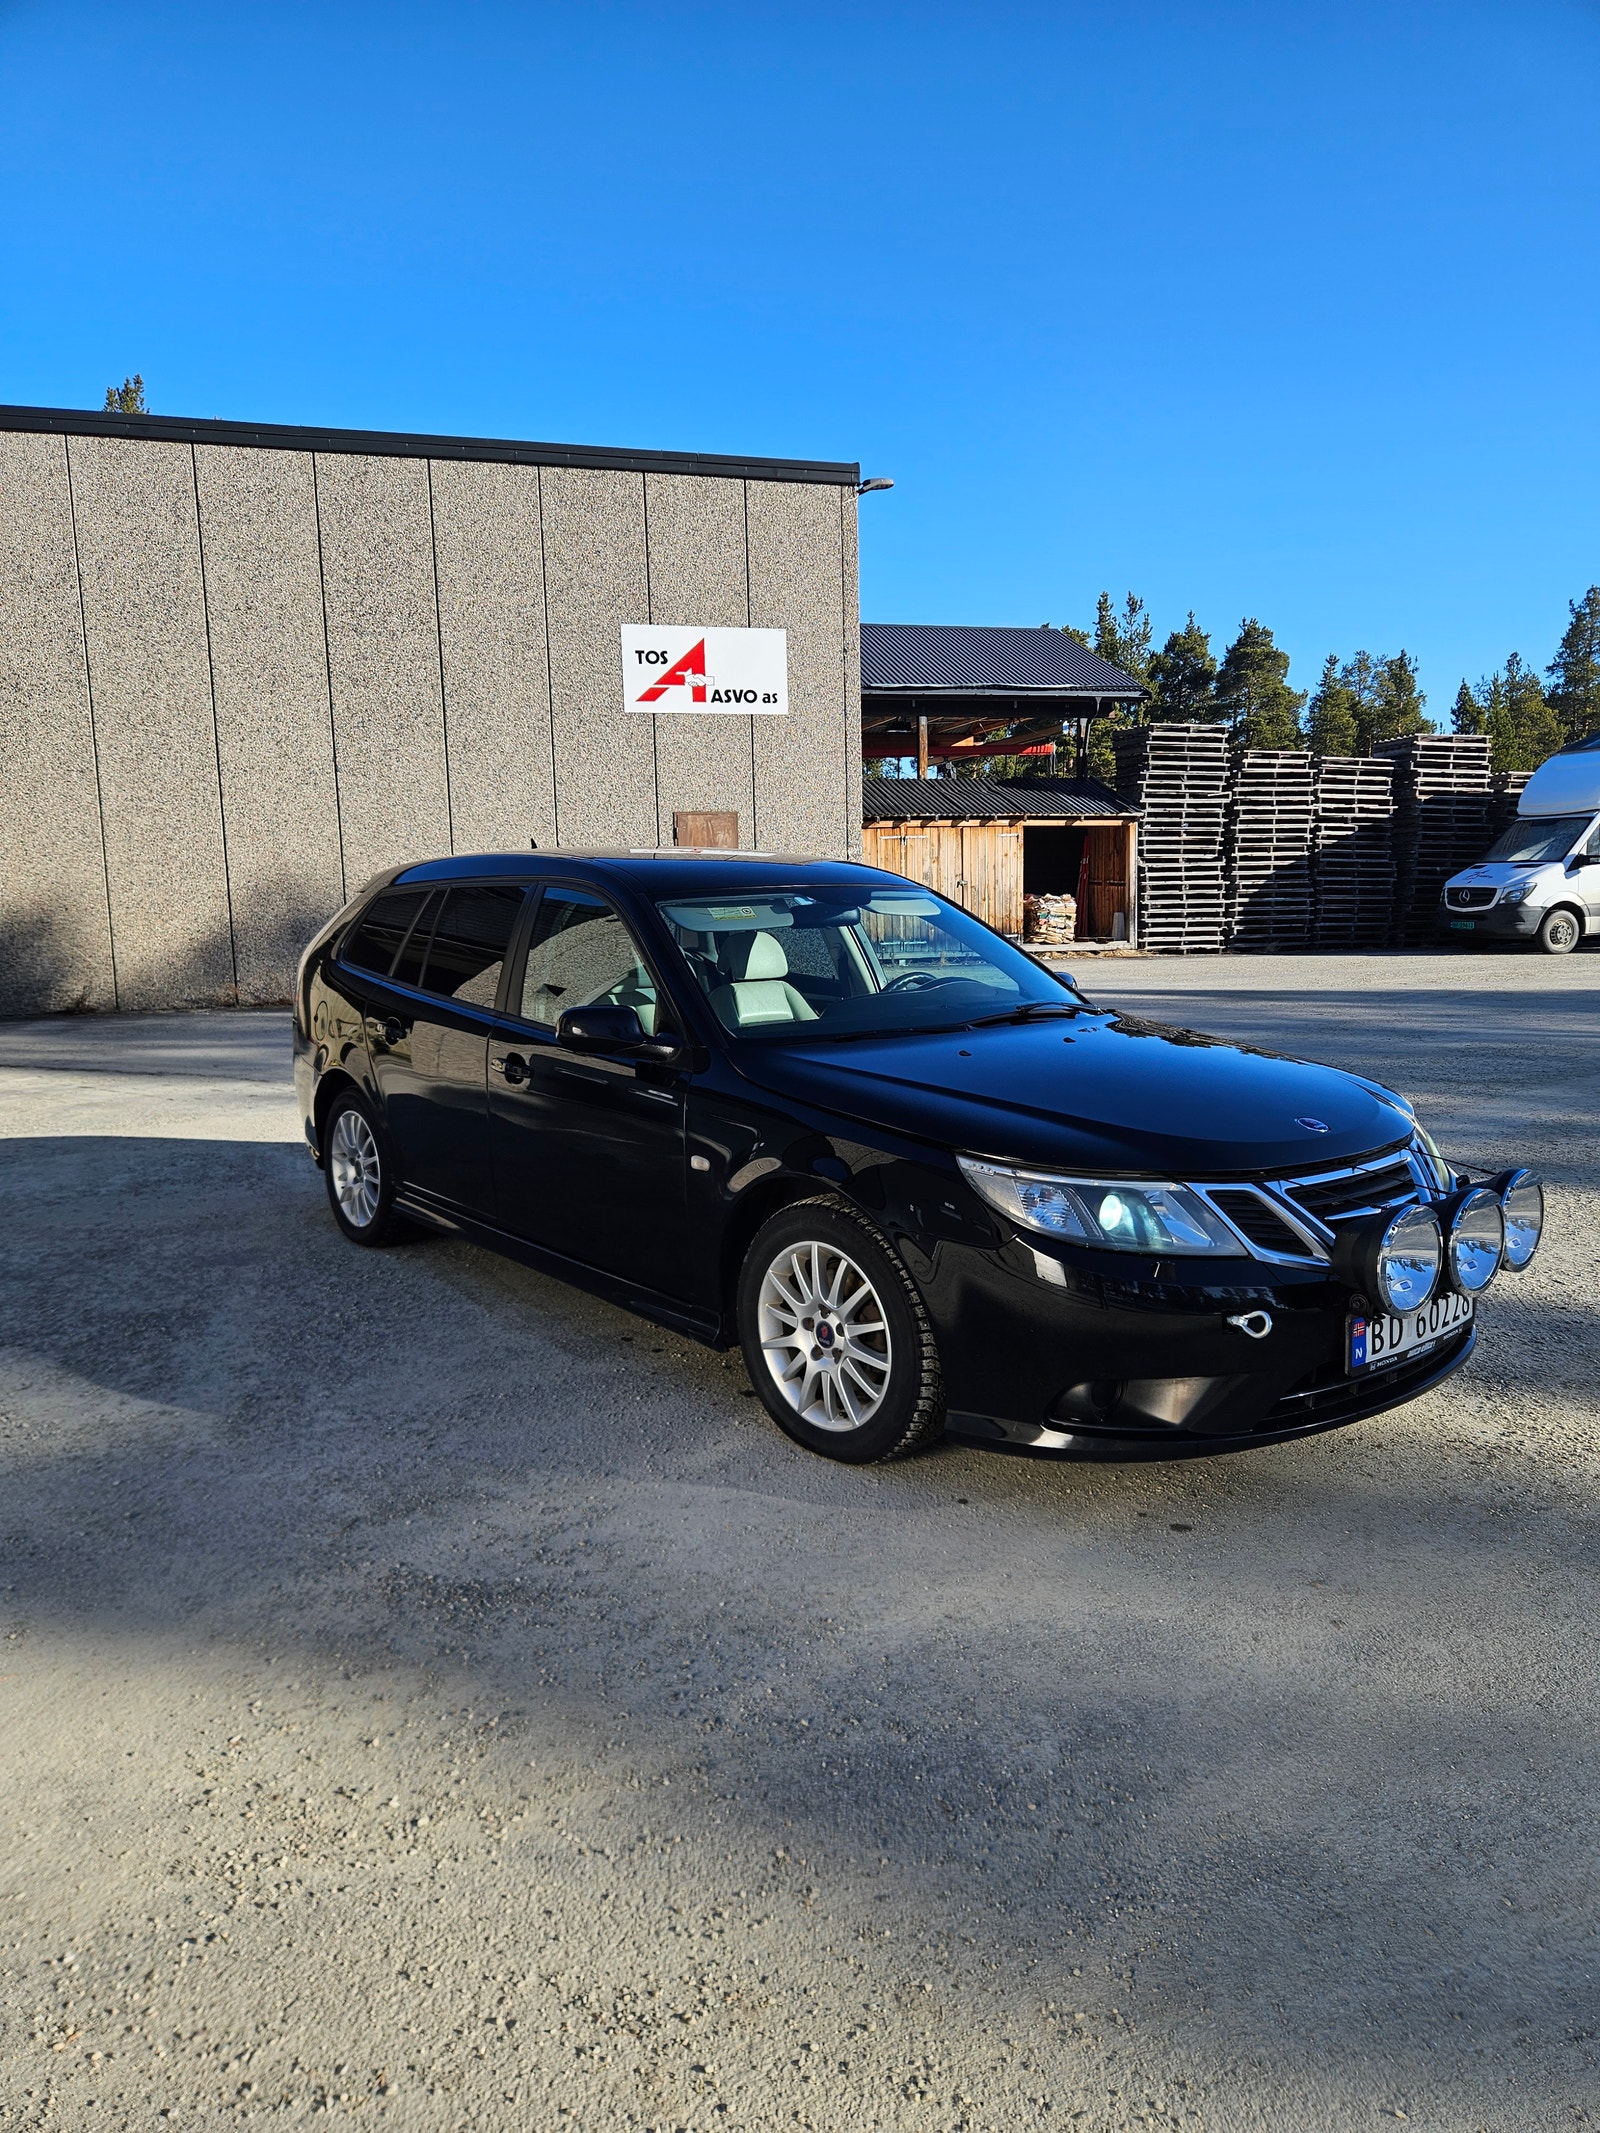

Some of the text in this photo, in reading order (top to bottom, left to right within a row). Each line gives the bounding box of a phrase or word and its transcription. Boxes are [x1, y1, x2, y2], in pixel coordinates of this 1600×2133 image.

[634, 650, 669, 665] TOS
[710, 689, 778, 704] ASVO as
[1371, 1315, 1404, 1356] BD
[1355, 1346, 1363, 1360] N
